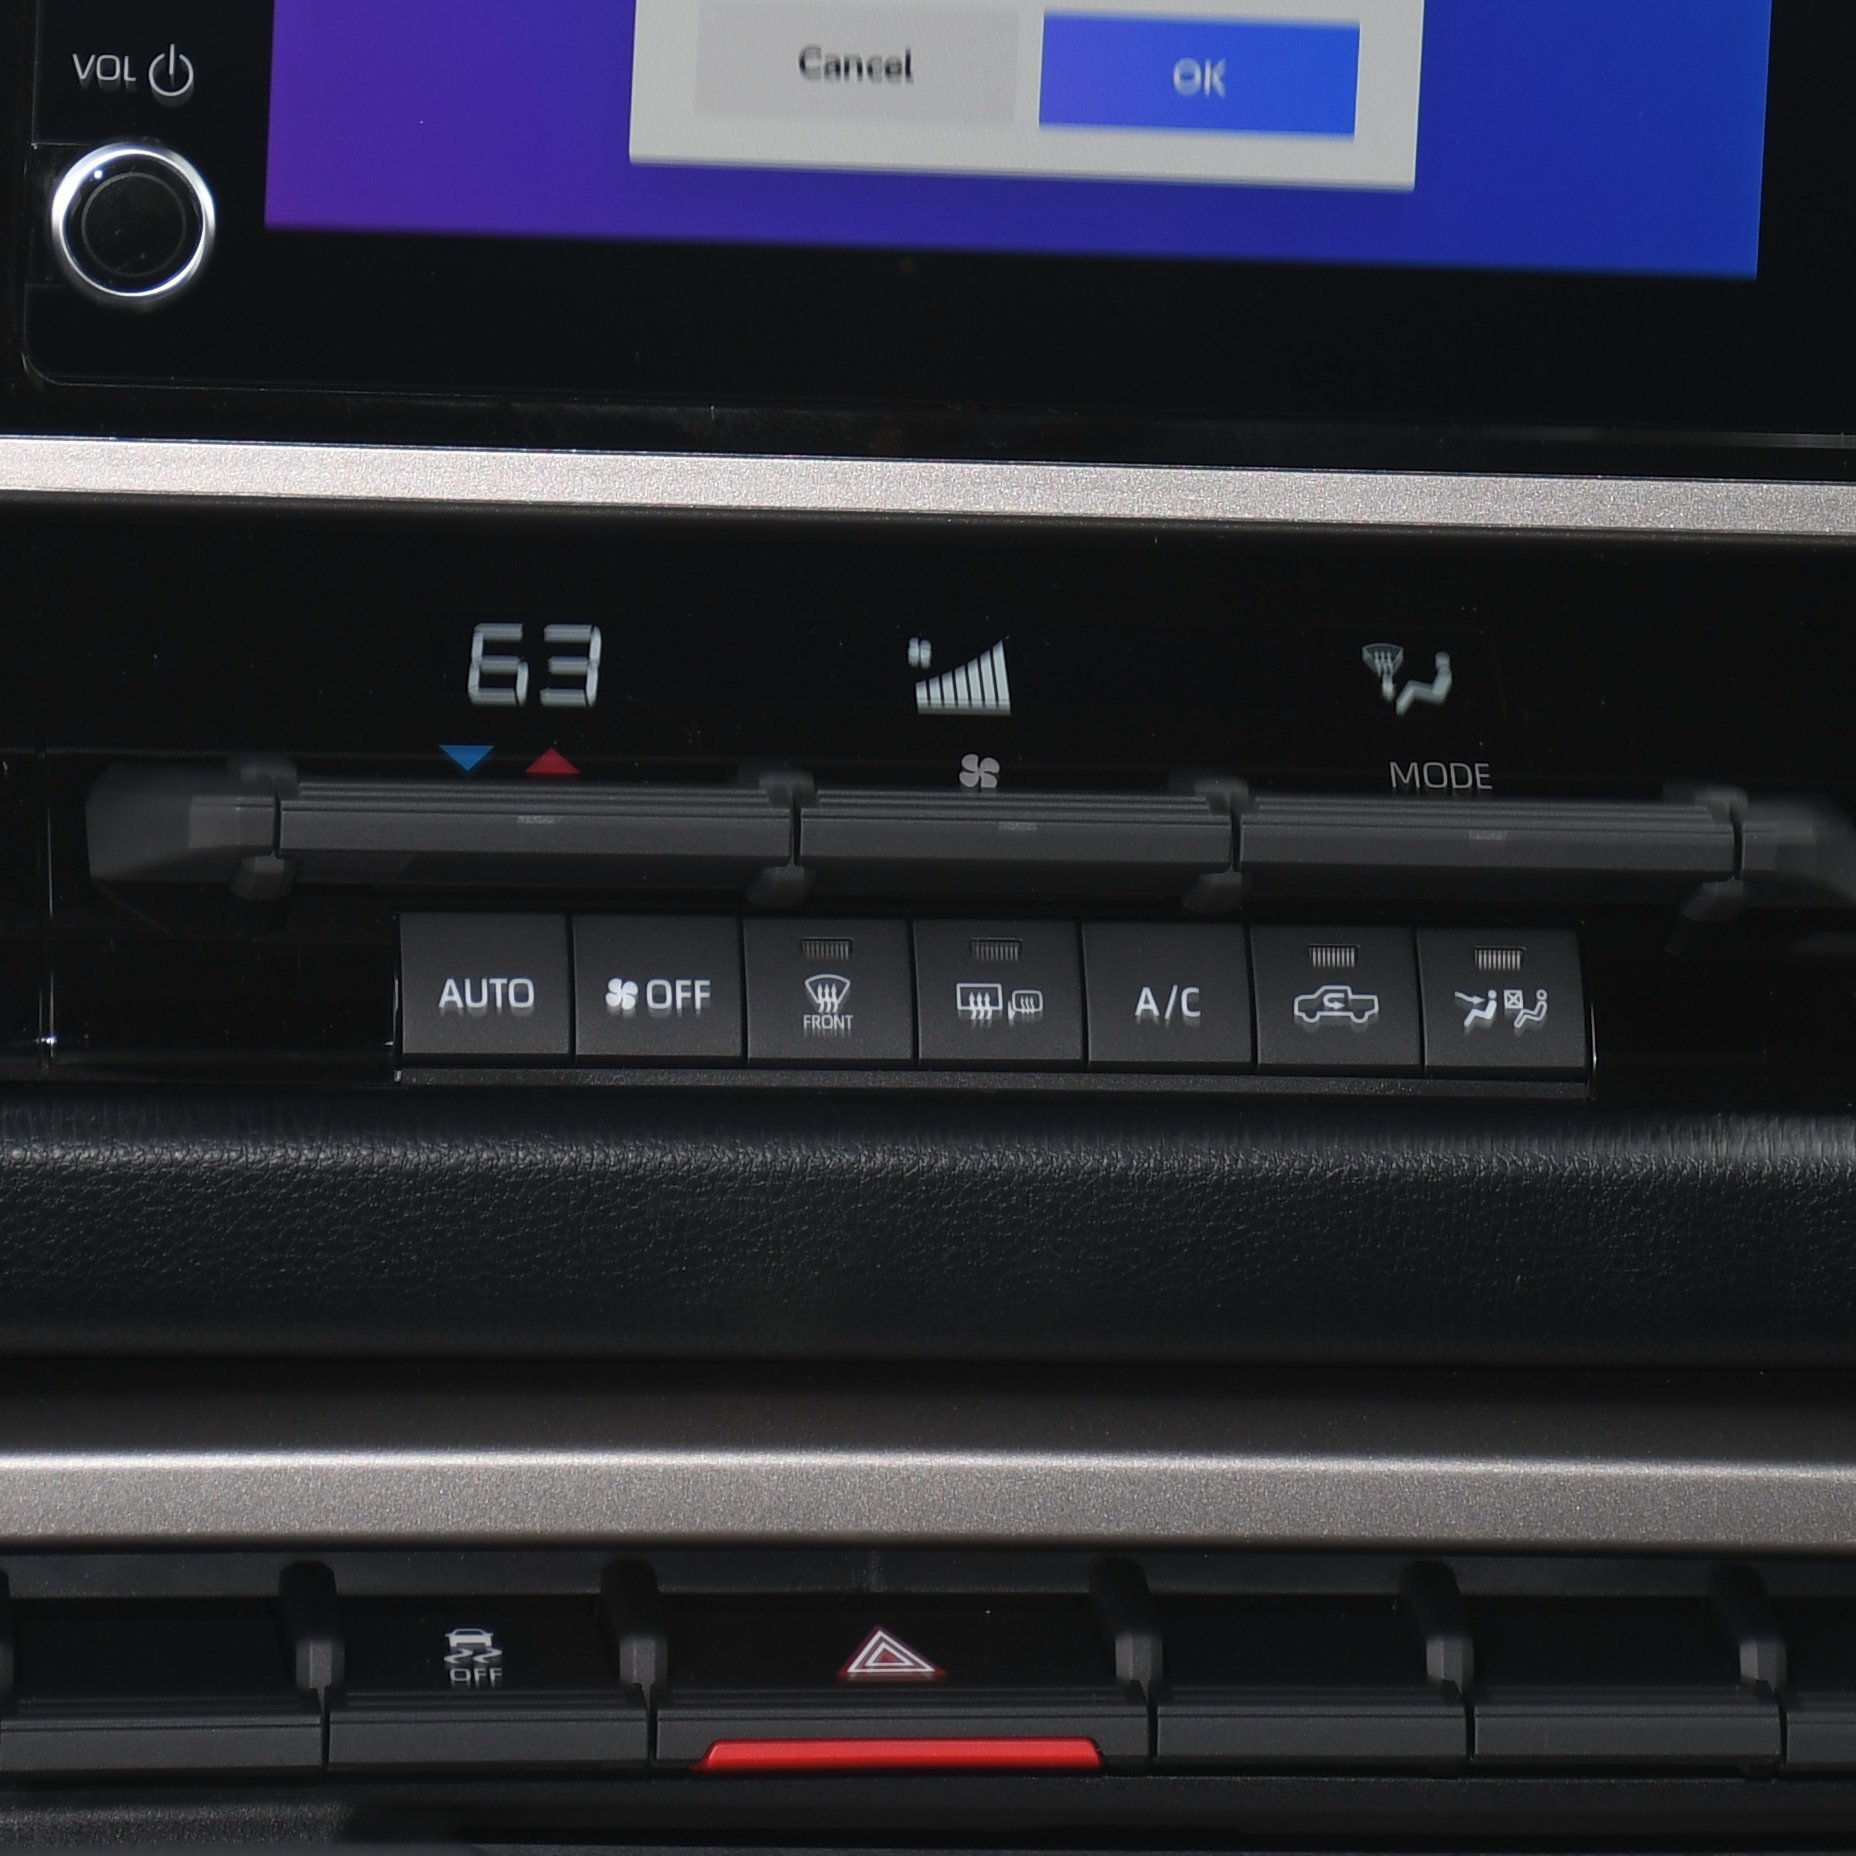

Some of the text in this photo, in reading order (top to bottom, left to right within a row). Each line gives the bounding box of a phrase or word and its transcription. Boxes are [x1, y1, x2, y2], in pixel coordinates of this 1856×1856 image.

[72, 53, 137, 82] VOL
[799, 45, 913, 85] Cancel
[1173, 56, 1226, 99] OK
[467, 622, 602, 706] 63
[1389, 760, 1493, 791] MODE
[439, 977, 535, 1010] AUTO
[646, 978, 711, 1011] OFF
[1135, 984, 1201, 1018] A/C
[803, 1014, 853, 1031] FRONT
[449, 1667, 502, 1682] OFF
